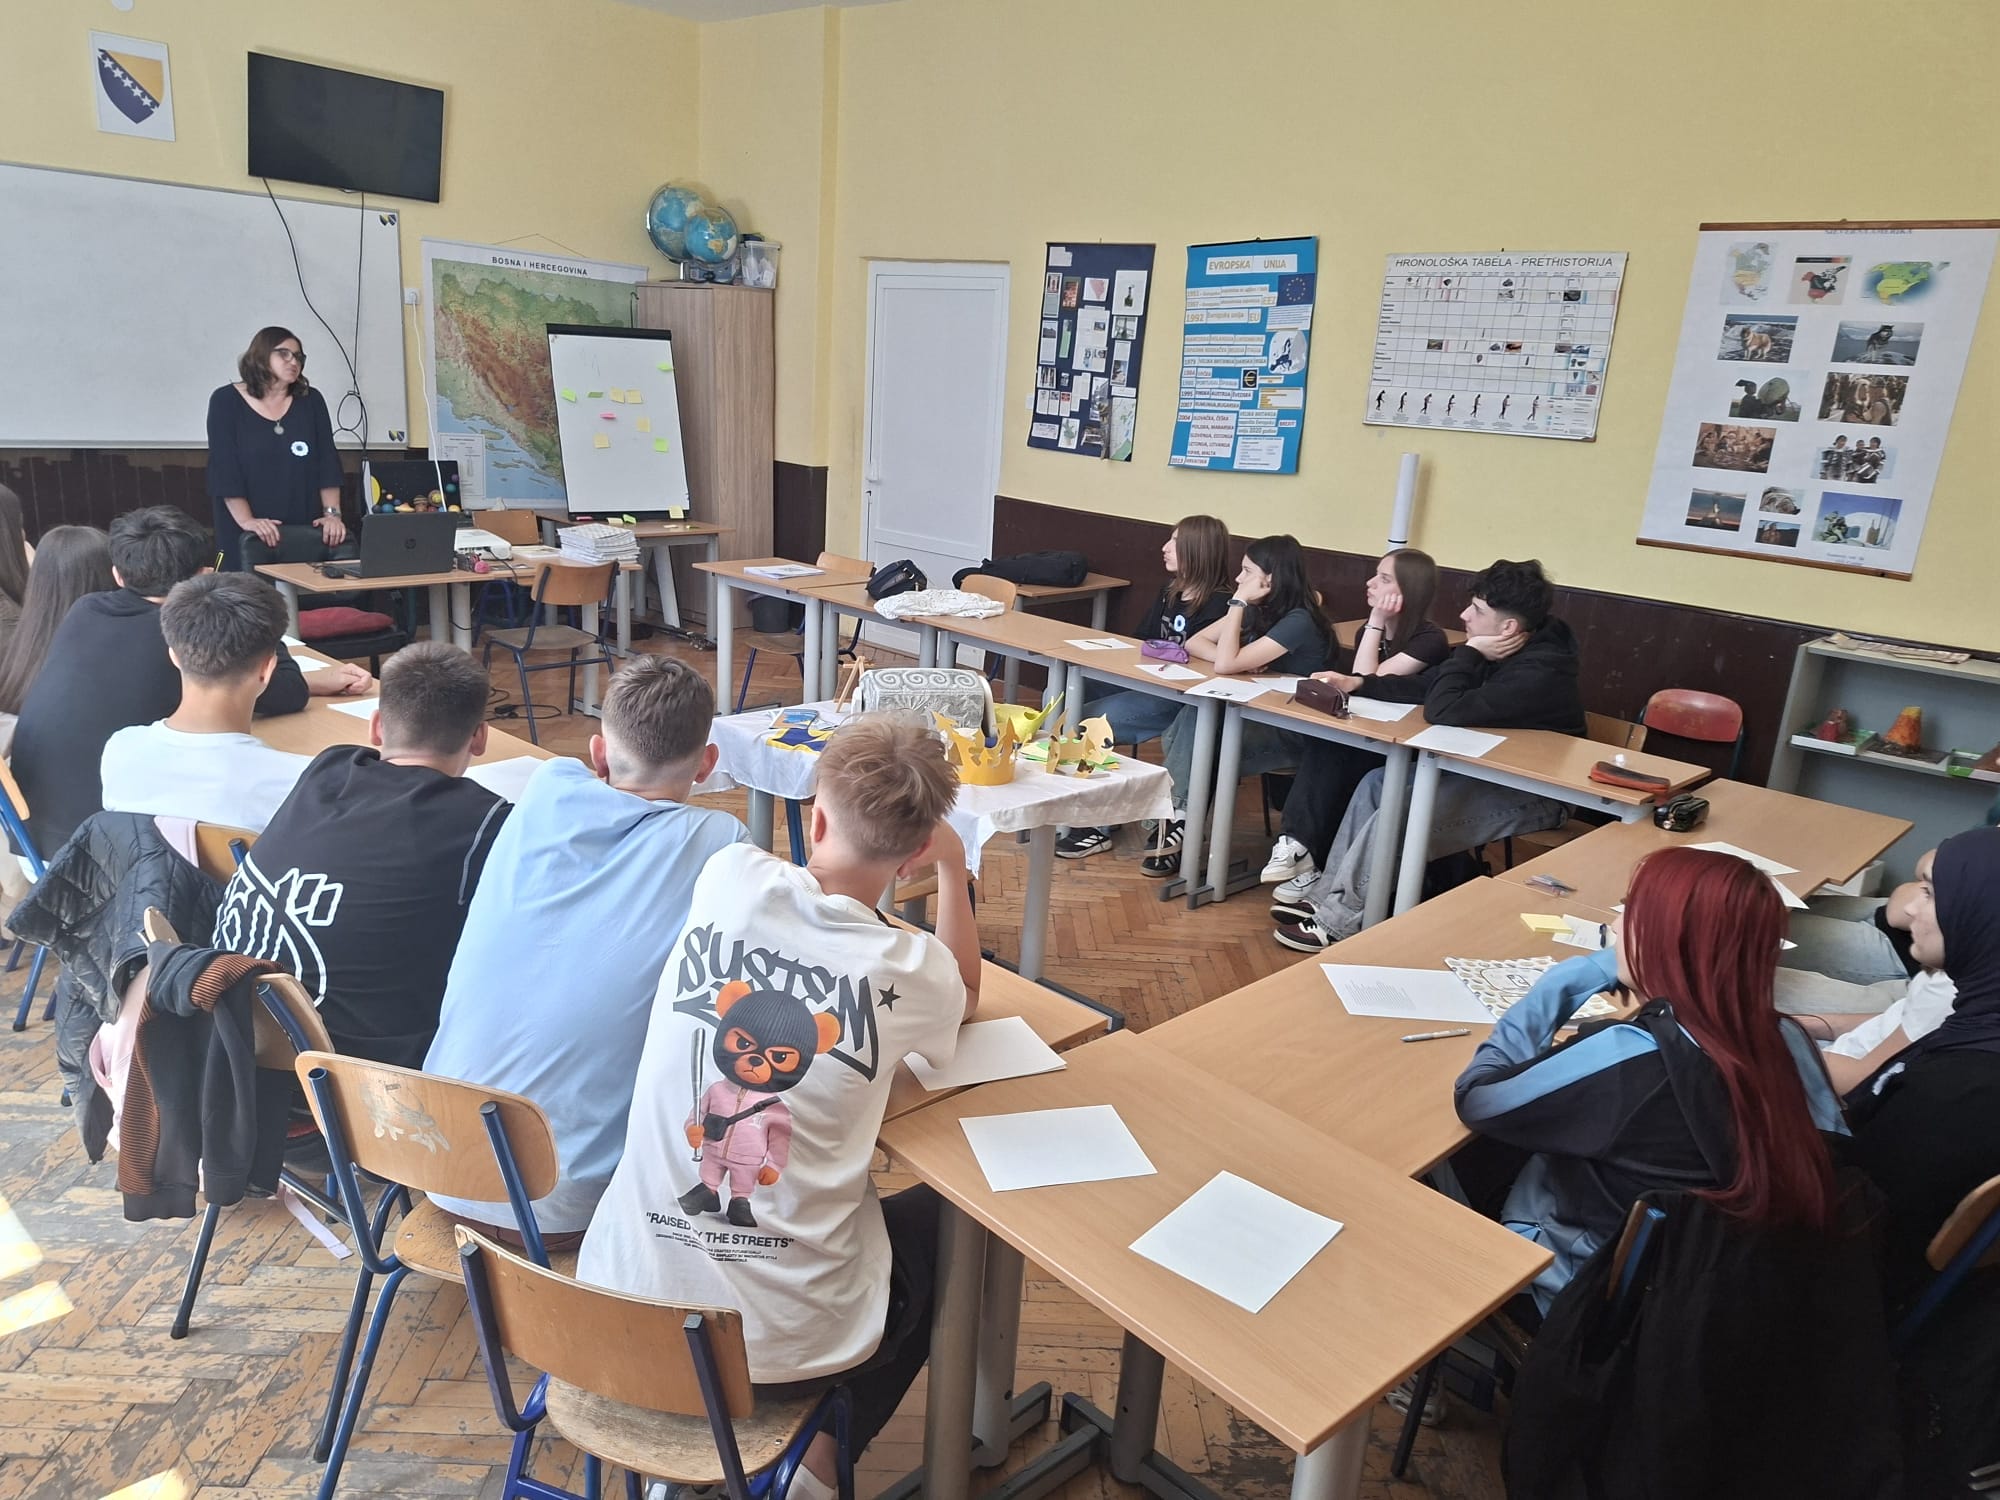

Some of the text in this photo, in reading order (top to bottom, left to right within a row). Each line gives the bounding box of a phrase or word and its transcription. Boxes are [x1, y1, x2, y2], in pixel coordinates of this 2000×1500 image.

[492, 256, 588, 275] BOSNA I HERCEGOVINA
[1209, 259, 1287, 270] EVROPSKA UNIJA
[1395, 256, 1468, 268] HRONOLOŠKA
[1472, 257, 1512, 267] TABELA
[1521, 257, 1613, 267] PRETHISTORIJA
[1187, 313, 1204, 322] 1992
[1250, 312, 1260, 321] EU
[646, 1212, 692, 1231] "RAISED
[705, 1231, 729, 1244] THE
[732, 1233, 795, 1249] STREETS"
